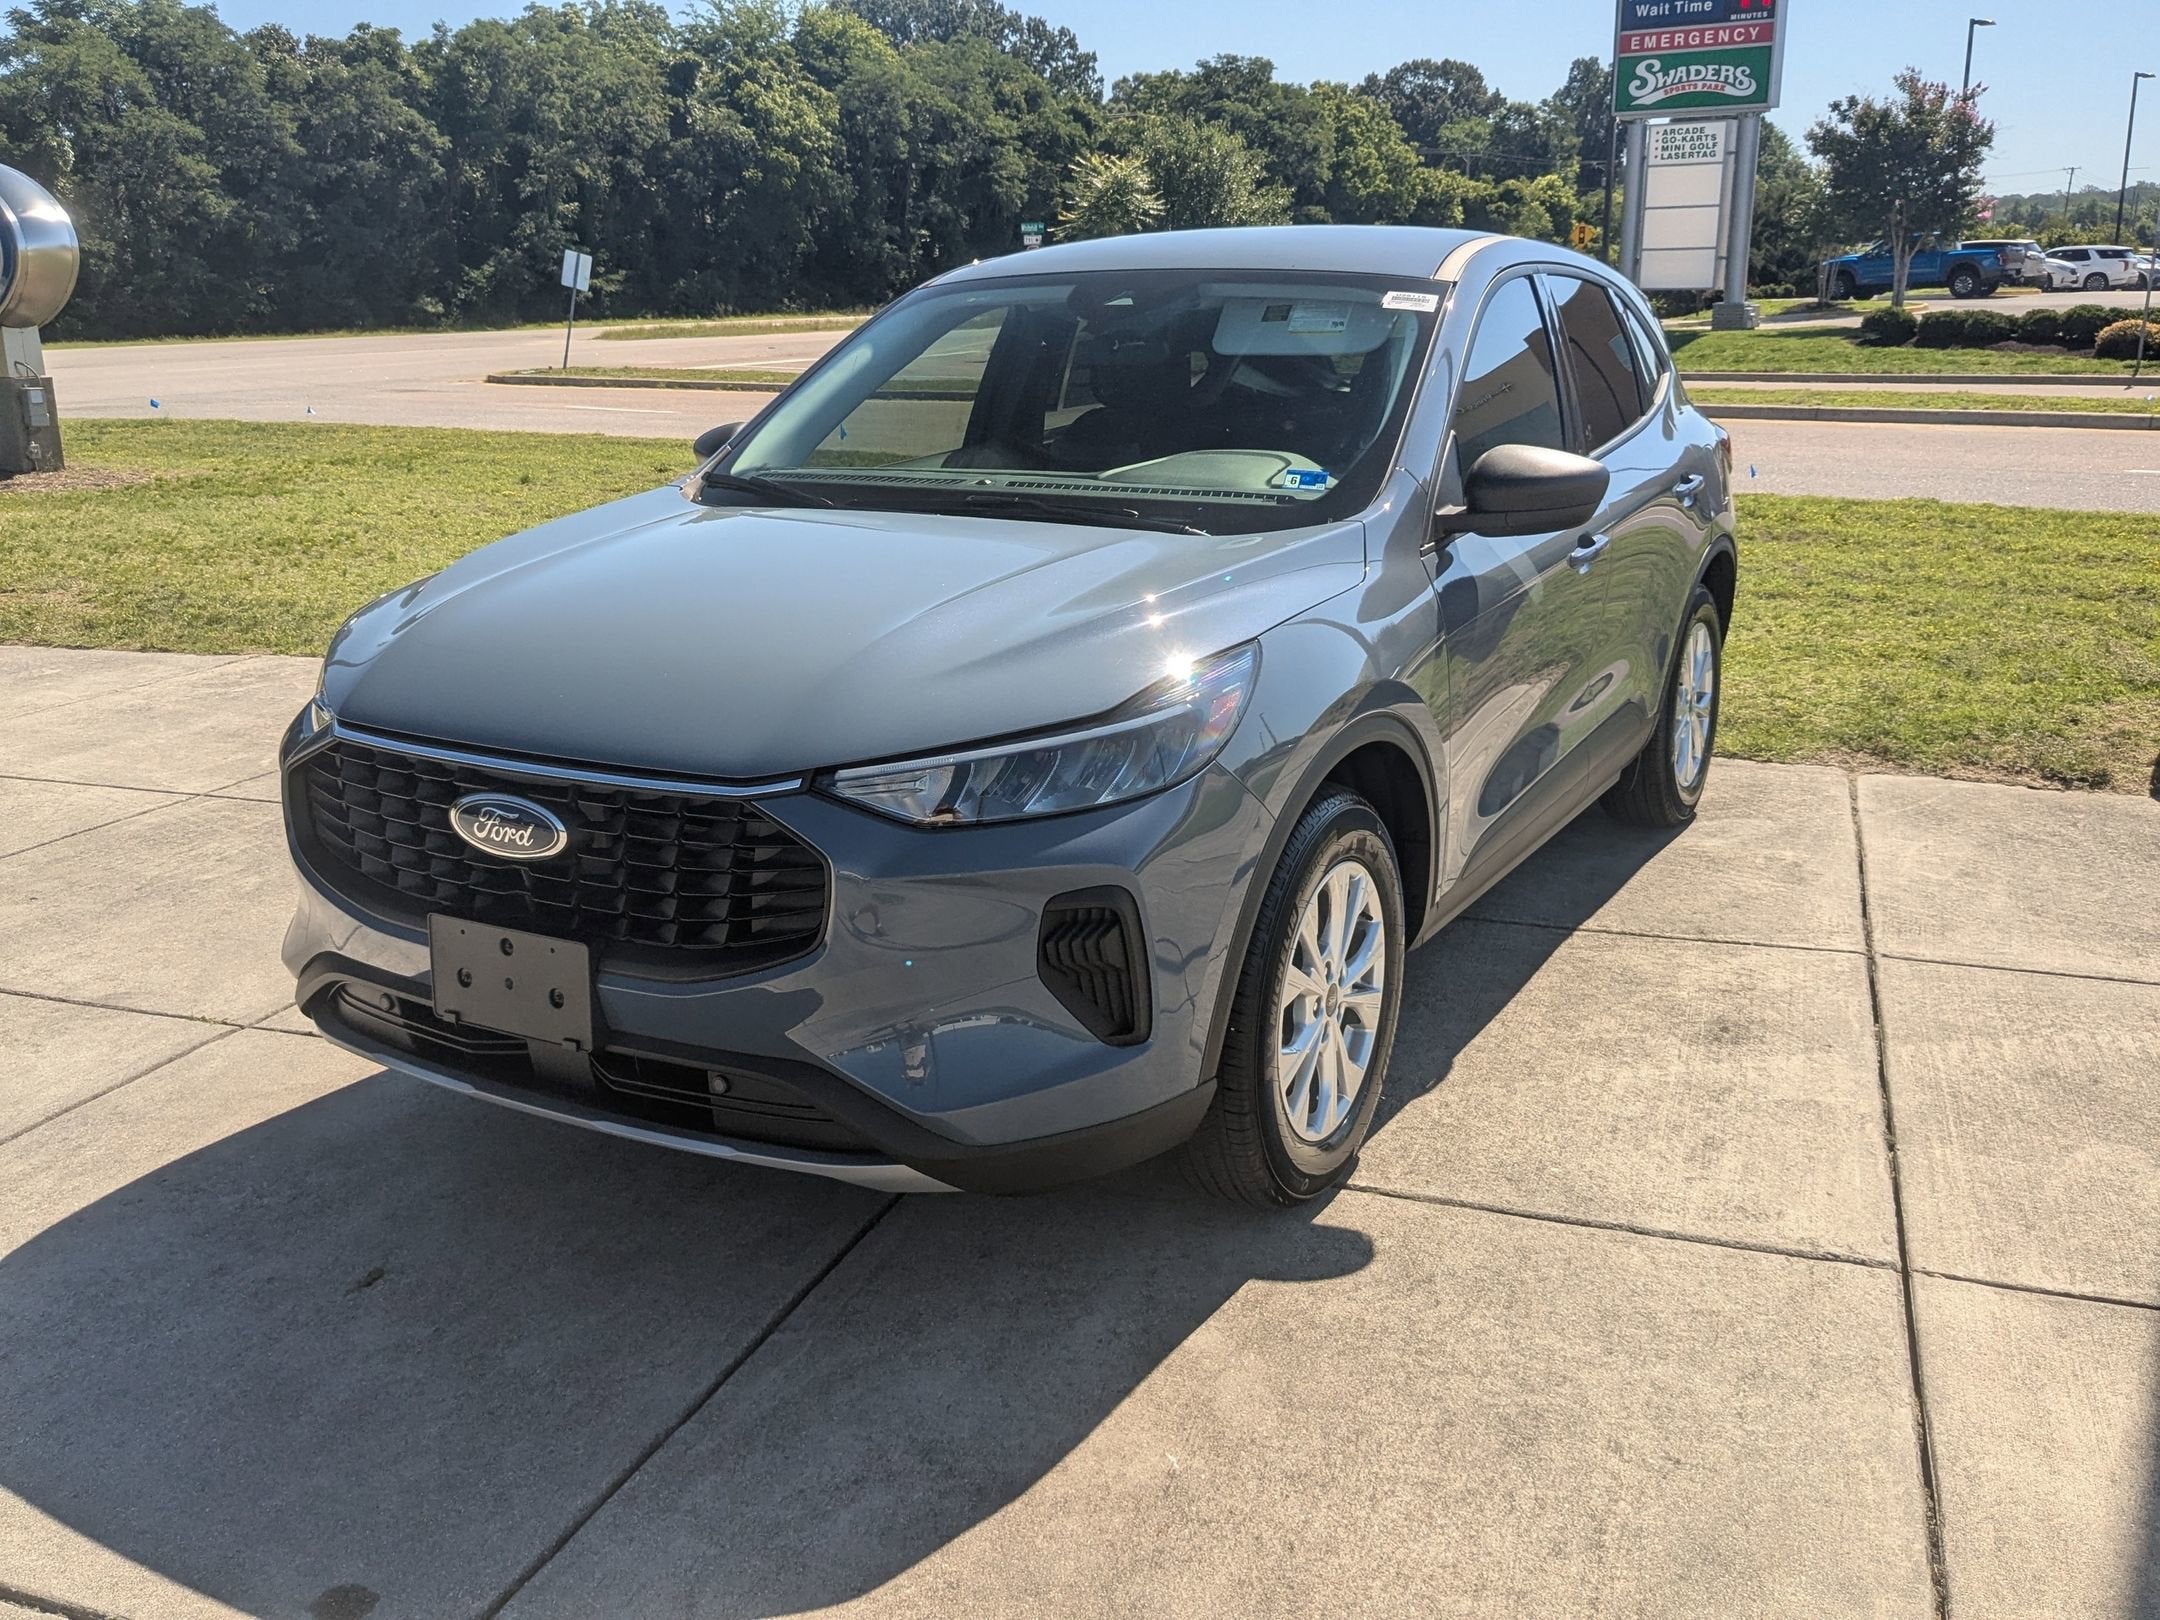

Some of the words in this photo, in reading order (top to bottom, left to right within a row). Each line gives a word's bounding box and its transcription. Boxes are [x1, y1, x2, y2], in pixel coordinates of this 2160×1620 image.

[1636, 4, 1670, 17] Wait
[1674, 1, 1713, 14] Time
[1730, 11, 1769, 20] MINUTES
[1630, 26, 1760, 49] EMERGENCY
[1663, 83, 1698, 96] SPORTS
[1701, 83, 1726, 92] PARK
[1661, 126, 1706, 137] ARCADE
[1661, 134, 1717, 144] GO-KARTS
[1660, 144, 1686, 153] MINI
[1689, 142, 1718, 151] GOLF
[1660, 150, 1717, 160] LASERTAG
[473, 807, 534, 847] Ford
